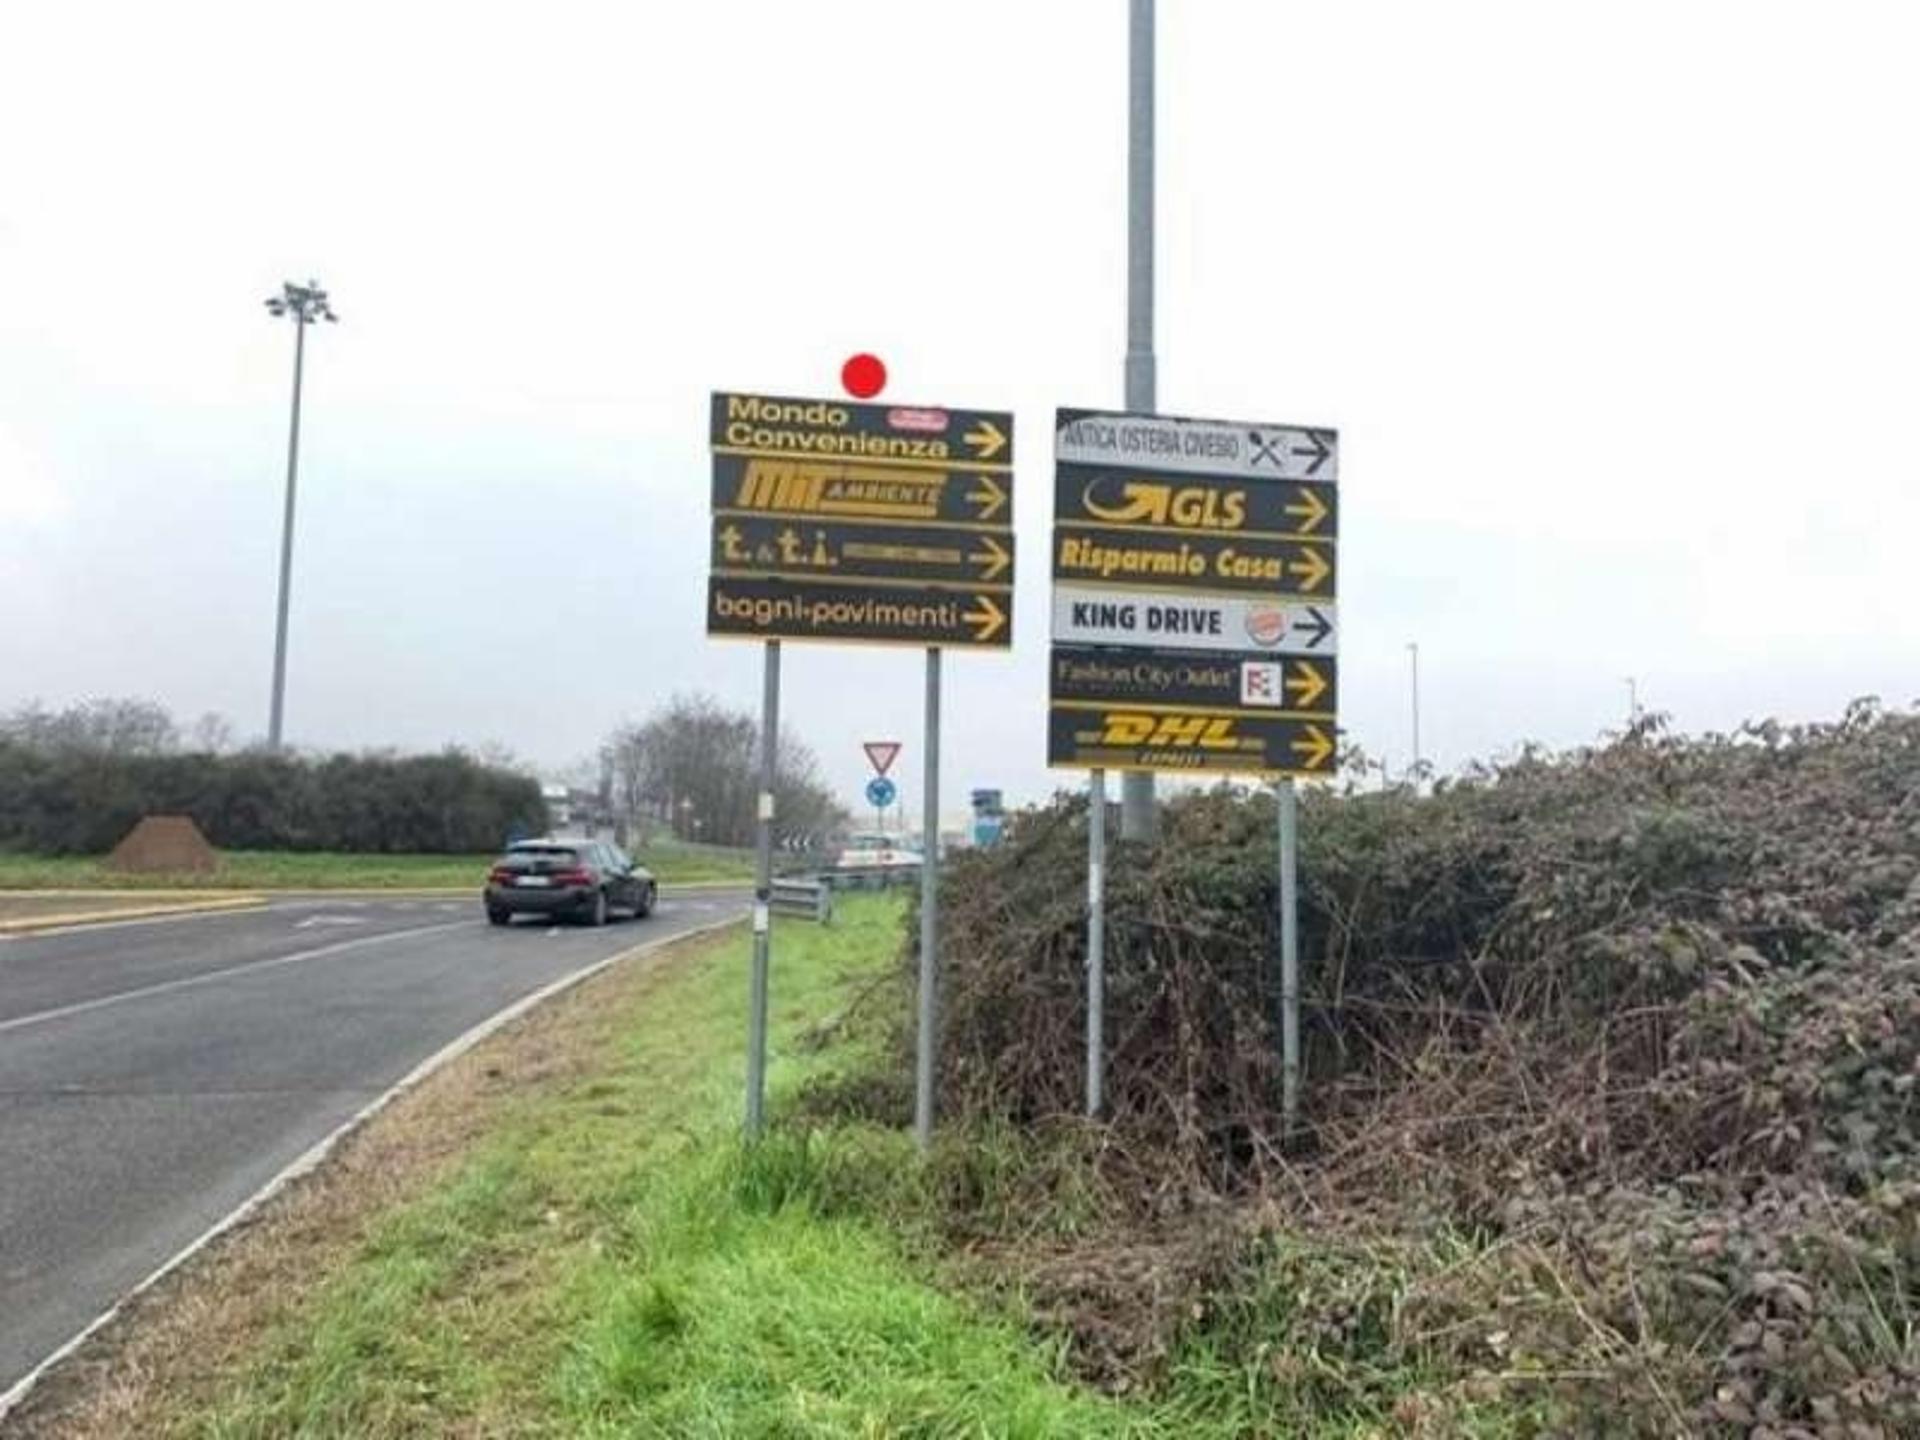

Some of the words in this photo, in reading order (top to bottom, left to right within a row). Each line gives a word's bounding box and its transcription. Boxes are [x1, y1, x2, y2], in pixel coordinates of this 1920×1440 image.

[727, 397, 848, 427] Mondo
[726, 423, 949, 458] Convenienza
[1171, 487, 1246, 528] GLS
[1060, 538, 1206, 576] Risparmio
[1216, 549, 1282, 578] Casa
[1072, 602, 1136, 630] KING
[1147, 606, 1223, 635] DRIVE
[1103, 713, 1240, 748] DHL
